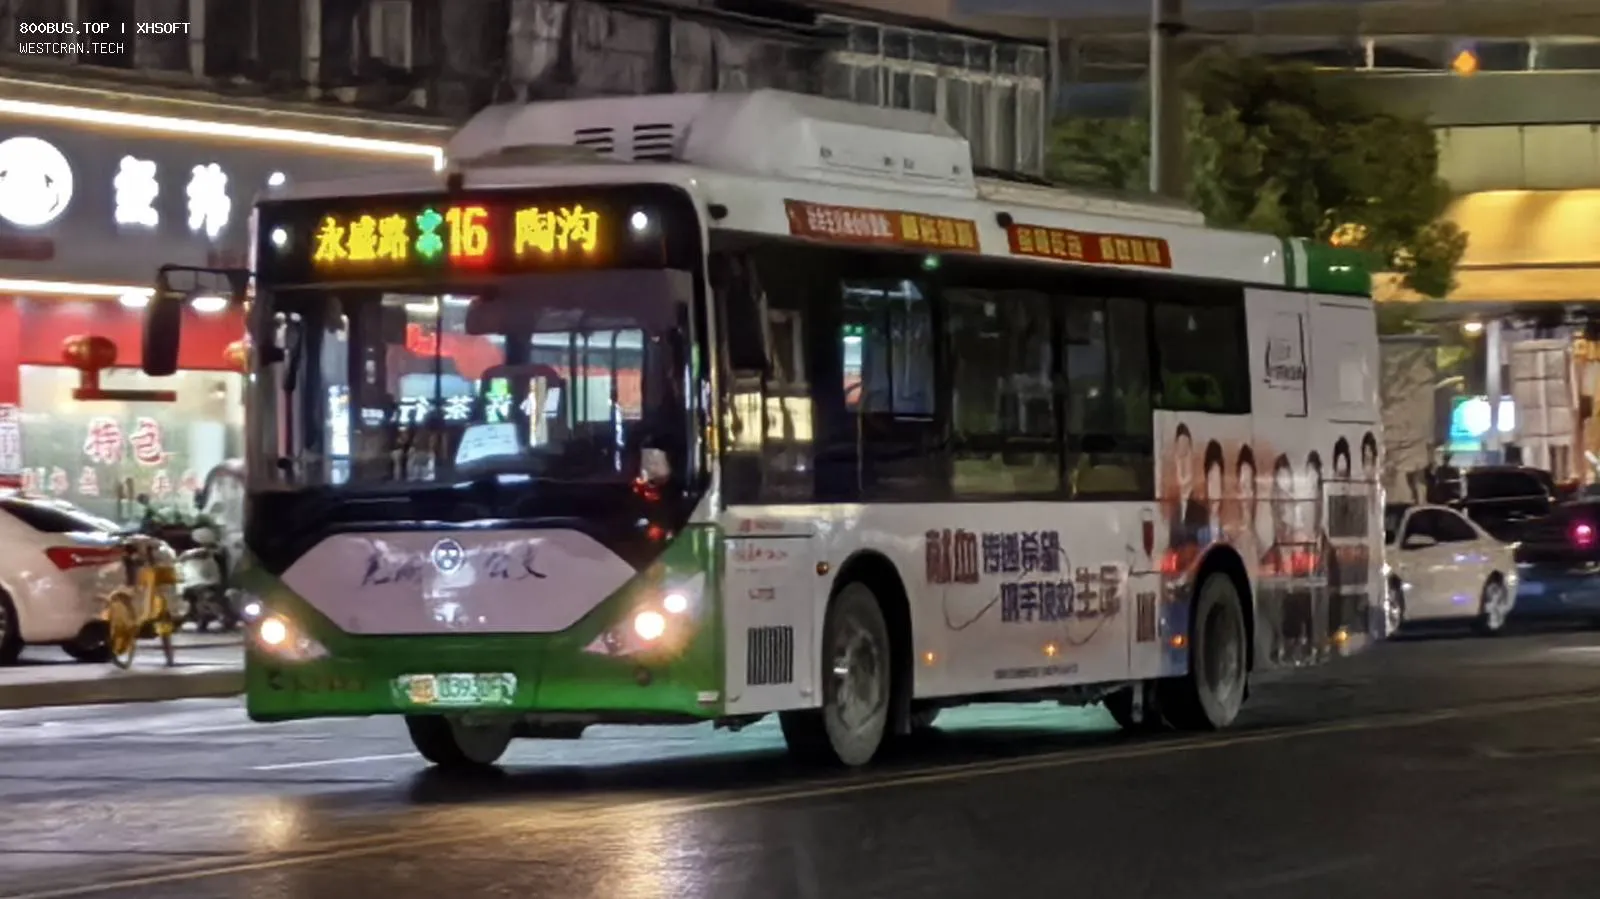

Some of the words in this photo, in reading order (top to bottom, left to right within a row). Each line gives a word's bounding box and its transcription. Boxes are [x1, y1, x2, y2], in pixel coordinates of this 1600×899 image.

[314, 214, 410, 261] 永盛路
[445, 206, 488, 256] 16
[514, 204, 599, 254] 陶沟
